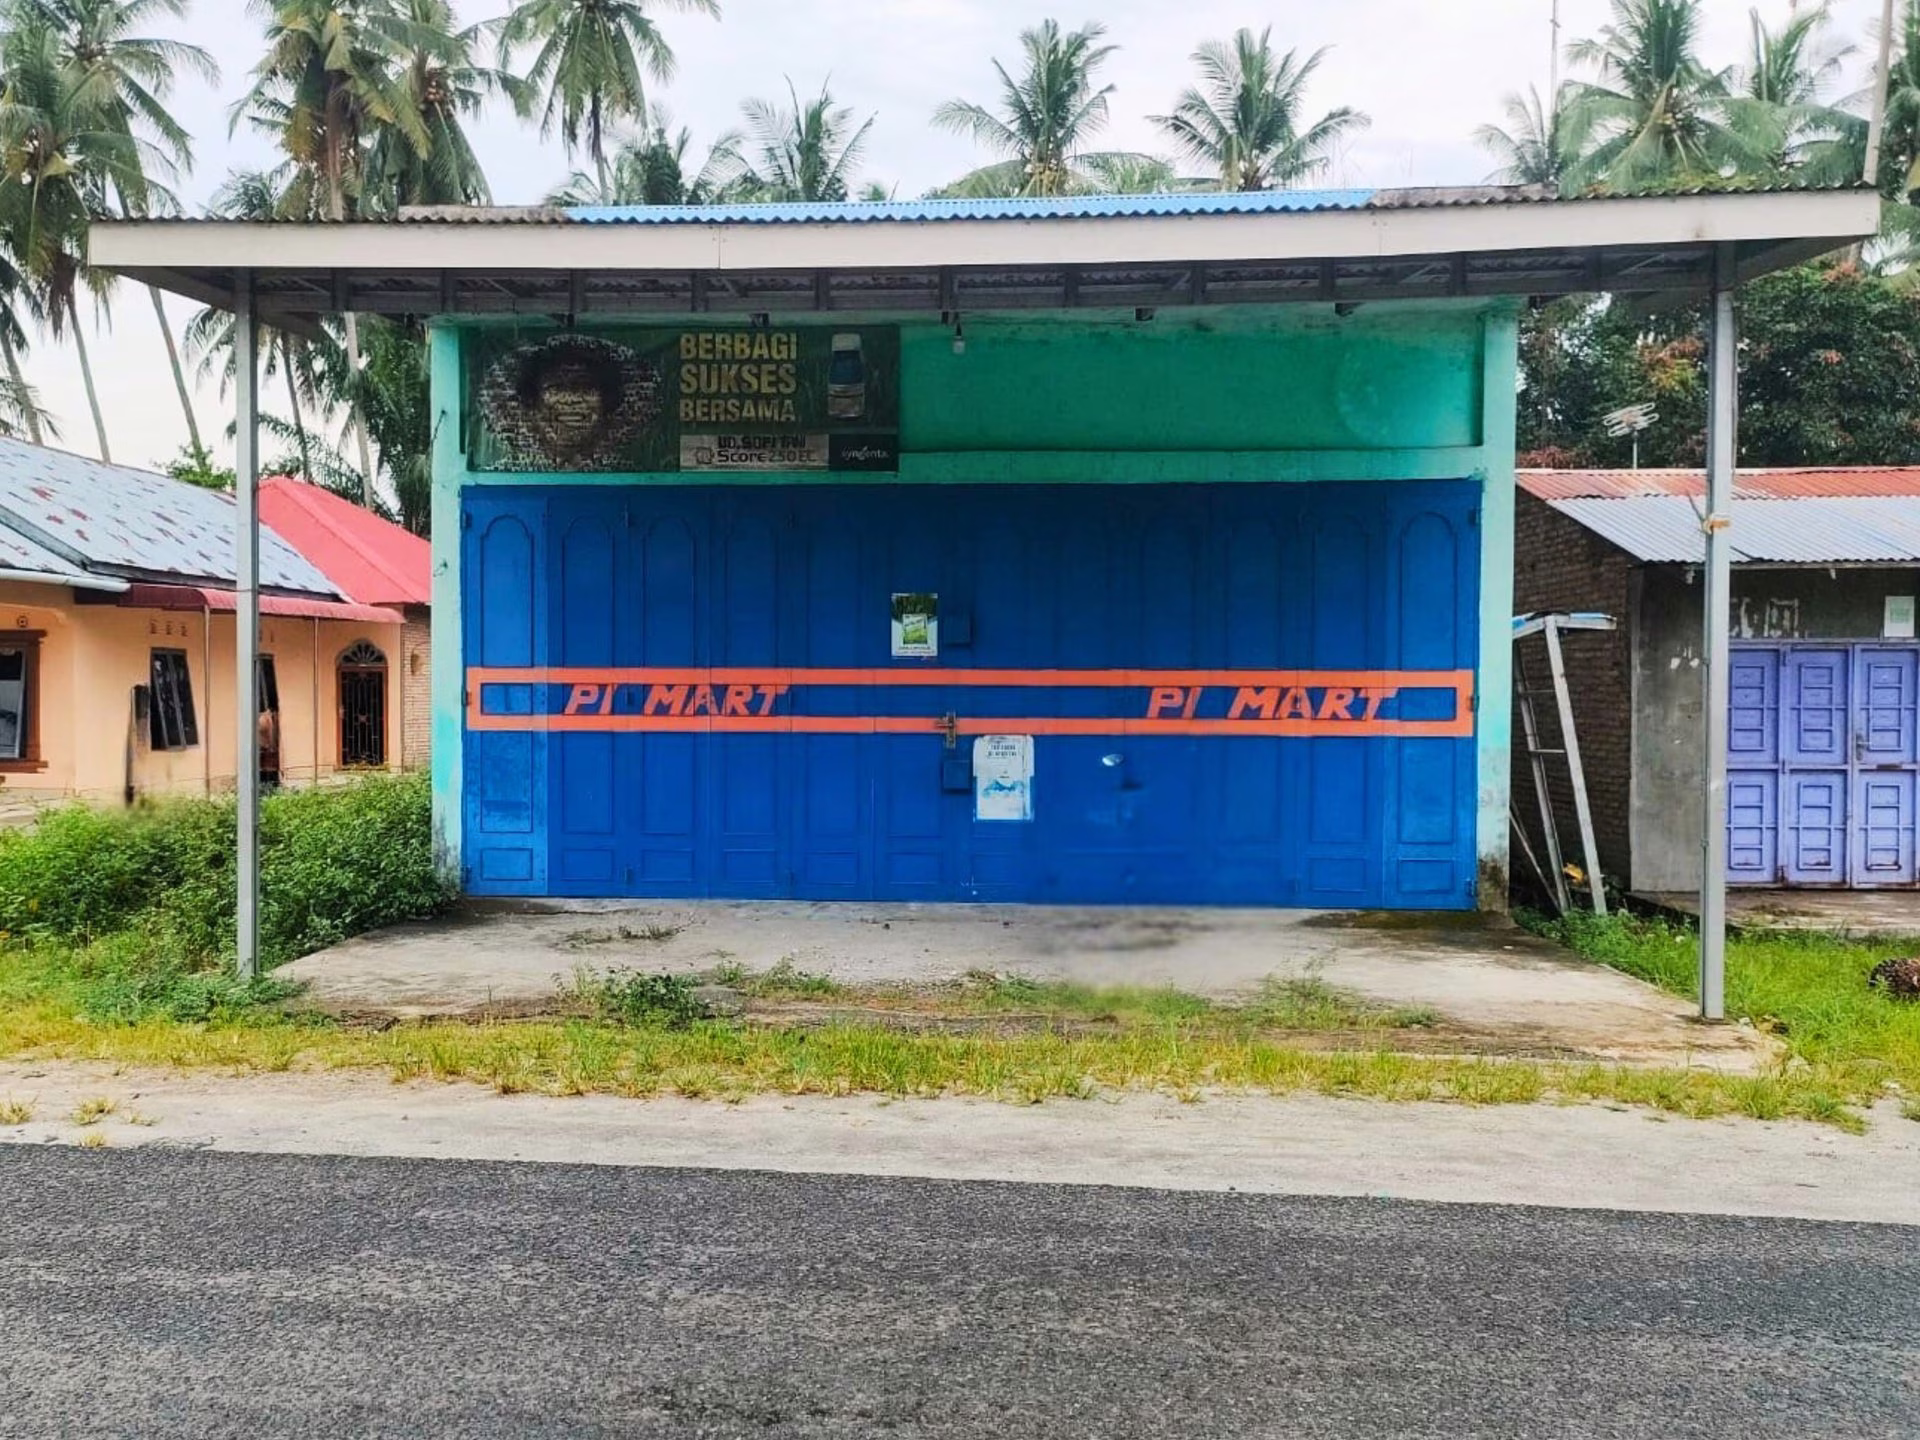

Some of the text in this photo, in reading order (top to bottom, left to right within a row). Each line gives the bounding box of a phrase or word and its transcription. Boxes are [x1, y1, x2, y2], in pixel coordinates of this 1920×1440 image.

[680, 333, 797, 360] BERBAGI
[680, 364, 796, 394] SUKSES
[680, 399, 796, 422] BERSAMA
[718, 450, 767, 463] Score
[564, 683, 791, 716] PI MART
[1147, 687, 1399, 720] PI MART
